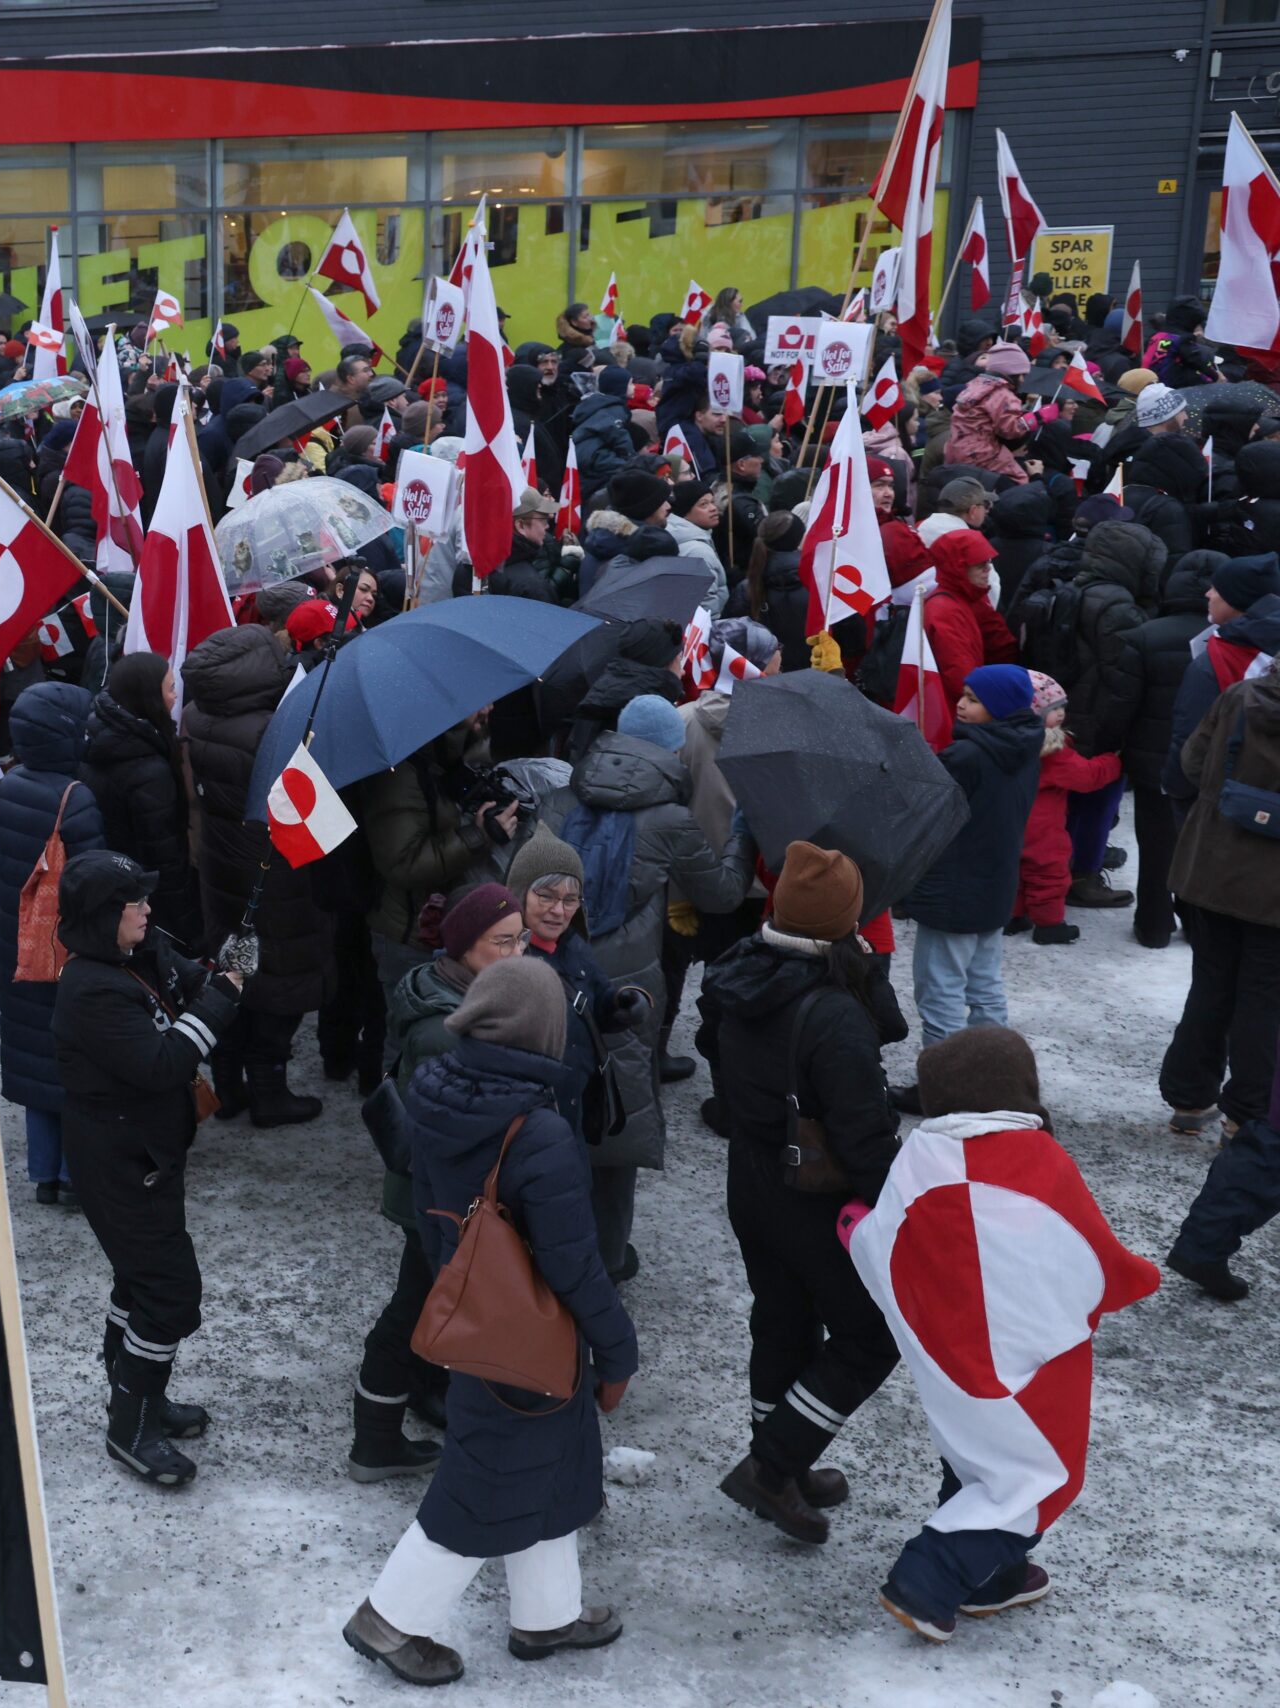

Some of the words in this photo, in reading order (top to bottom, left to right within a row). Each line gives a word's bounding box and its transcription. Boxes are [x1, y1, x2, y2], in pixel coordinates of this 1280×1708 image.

[1163, 182, 1171, 191] A
[1050, 239, 1093, 253] SPAR
[1052, 258, 1088, 272] 50%
[1051, 276, 1091, 289] LLER
[770, 351, 785, 359] NOT
[823, 349, 838, 360] Not
[838, 347, 852, 363] for
[825, 360, 849, 374] Sale
[403, 488, 418, 502] Not
[417, 489, 433, 506] for
[406, 502, 429, 519] Sale
